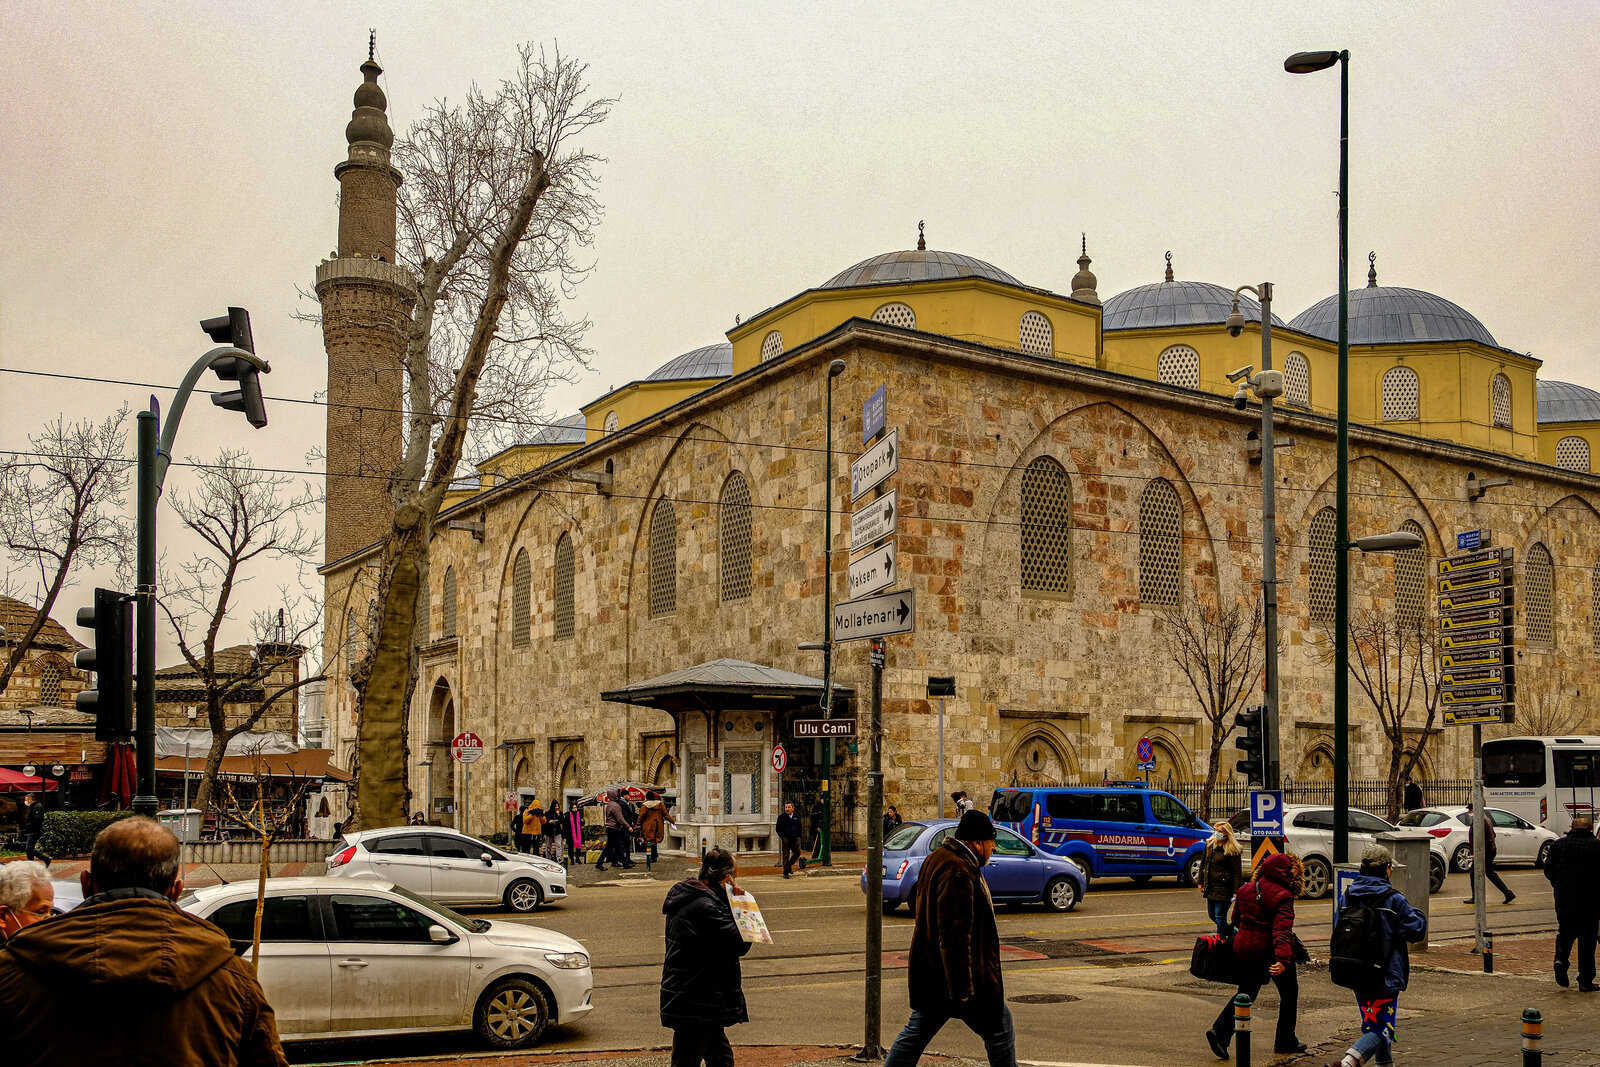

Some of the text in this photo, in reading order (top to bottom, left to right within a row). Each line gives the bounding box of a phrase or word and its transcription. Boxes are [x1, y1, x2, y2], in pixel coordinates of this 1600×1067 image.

[859, 449, 886, 482] Otopark
[850, 568, 877, 589] Maksem
[835, 607, 895, 630] Mollafenari
[800, 723, 851, 734] Ulu Cami
[457, 739, 478, 747] DUR
[239, 775, 258, 783] PAZA
[1257, 794, 1276, 819] P
[1098, 834, 1146, 845] JANDARMA
